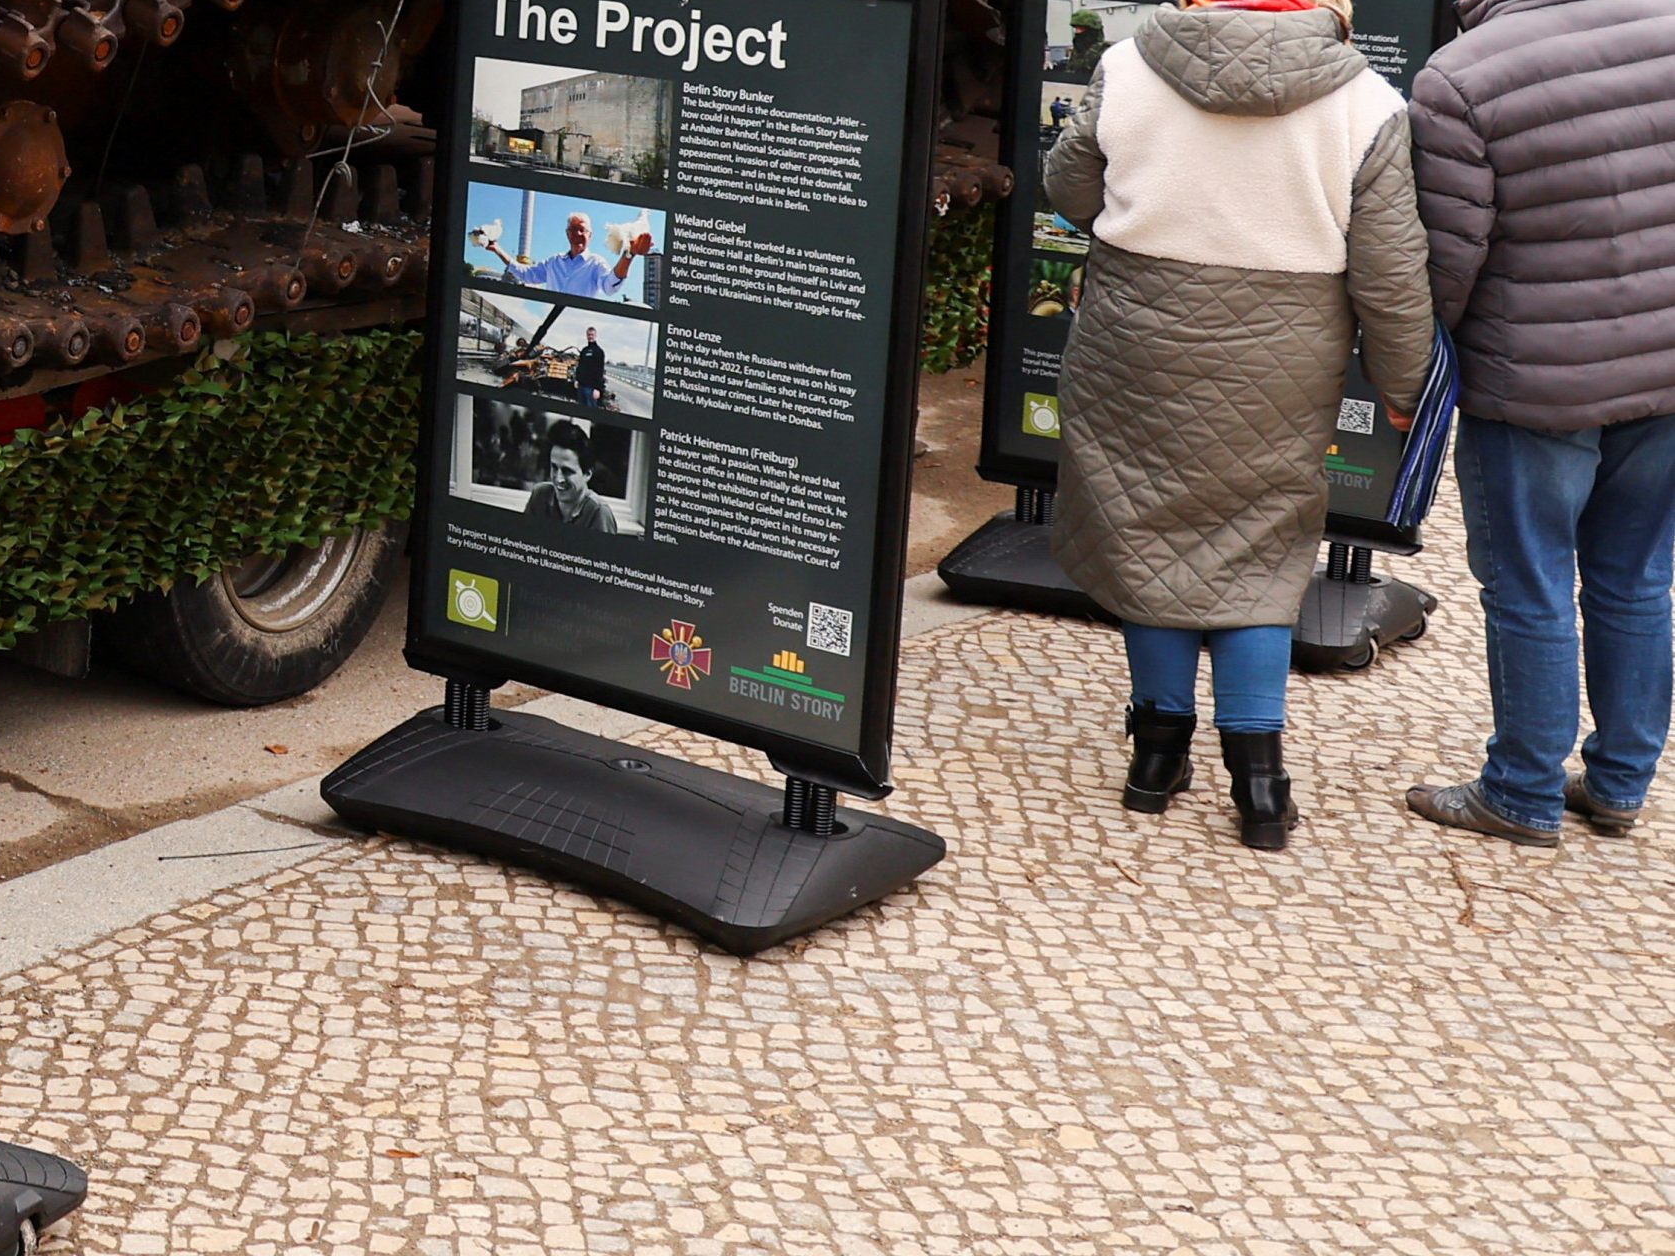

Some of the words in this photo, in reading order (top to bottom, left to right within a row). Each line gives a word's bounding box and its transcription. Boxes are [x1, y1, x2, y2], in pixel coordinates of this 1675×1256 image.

[595, 0, 787, 72] Project
[1368, 34, 1400, 43] national
[1371, 45, 1401, 54] country
[1390, 56, 1408, 64] after
[683, 81, 711, 96] Berlin
[711, 85, 738, 101] Story
[738, 88, 774, 103] Bunker
[674, 212, 714, 229] Wieland
[714, 219, 746, 234] Giebel
[667, 323, 692, 338] Enno
[693, 328, 722, 344] Lenze
[665, 337, 679, 348] On
[679, 340, 694, 351] the
[694, 343, 711, 356] day
[711, 347, 735, 359] when
[735, 351, 750, 362] the
[751, 353, 787, 369] Russians
[788, 362, 830, 377] withdrew
[829, 367, 852, 381] from
[665, 350, 683, 362] Kyiv
[683, 353, 692, 364] in
[692, 355, 719, 369] March
[719, 360, 743, 375] 2022,
[743, 365, 766, 378] Enno
[766, 369, 792, 383] Lenze
[792, 376, 810, 387] was
[810, 380, 823, 389] on
[824, 380, 837, 392] his
[838, 385, 857, 398] way
[663, 365, 682, 375] past
[683, 366, 709, 380] Bucha
[709, 373, 726, 384] and
[726, 377, 744, 387] saw
[744, 378, 777, 394] families
[777, 385, 797, 398] shot
[797, 389, 807, 399] in
[807, 393, 828, 405] cars,
[828, 397, 853, 409] corp-
[659, 427, 692, 445] Patrick
[692, 435, 749, 457] Heinemann
[750, 447, 799, 469] (Freiburg)
[1326, 470, 1373, 490] STORY
[767, 602, 804, 619] Spenden
[772, 615, 803, 632] Donate
[729, 675, 785, 706] BERLIN
[790, 692, 844, 722] STORY
